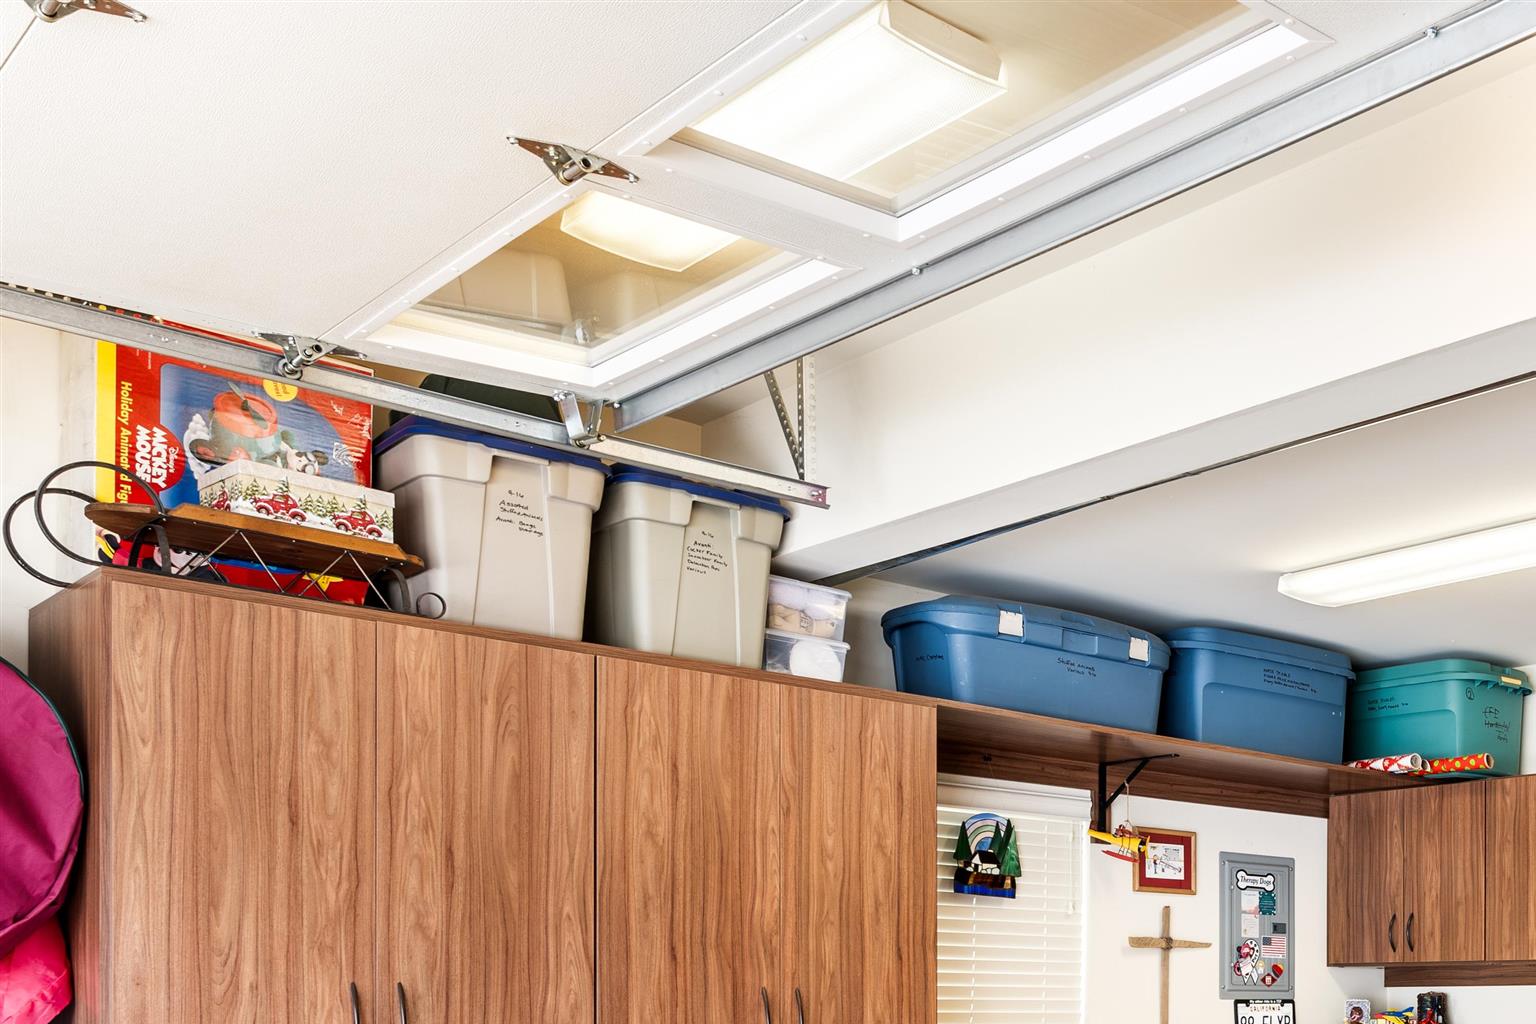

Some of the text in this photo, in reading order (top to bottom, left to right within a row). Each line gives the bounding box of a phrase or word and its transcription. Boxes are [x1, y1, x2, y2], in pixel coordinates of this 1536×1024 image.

[117, 381, 133, 425] Holiday
[120, 427, 133, 482] Animatd
[135, 424, 152, 484] MOUSE
[151, 426, 168, 489] MICKEY
[1249, 1004, 1282, 1013] CALIFORNIA
